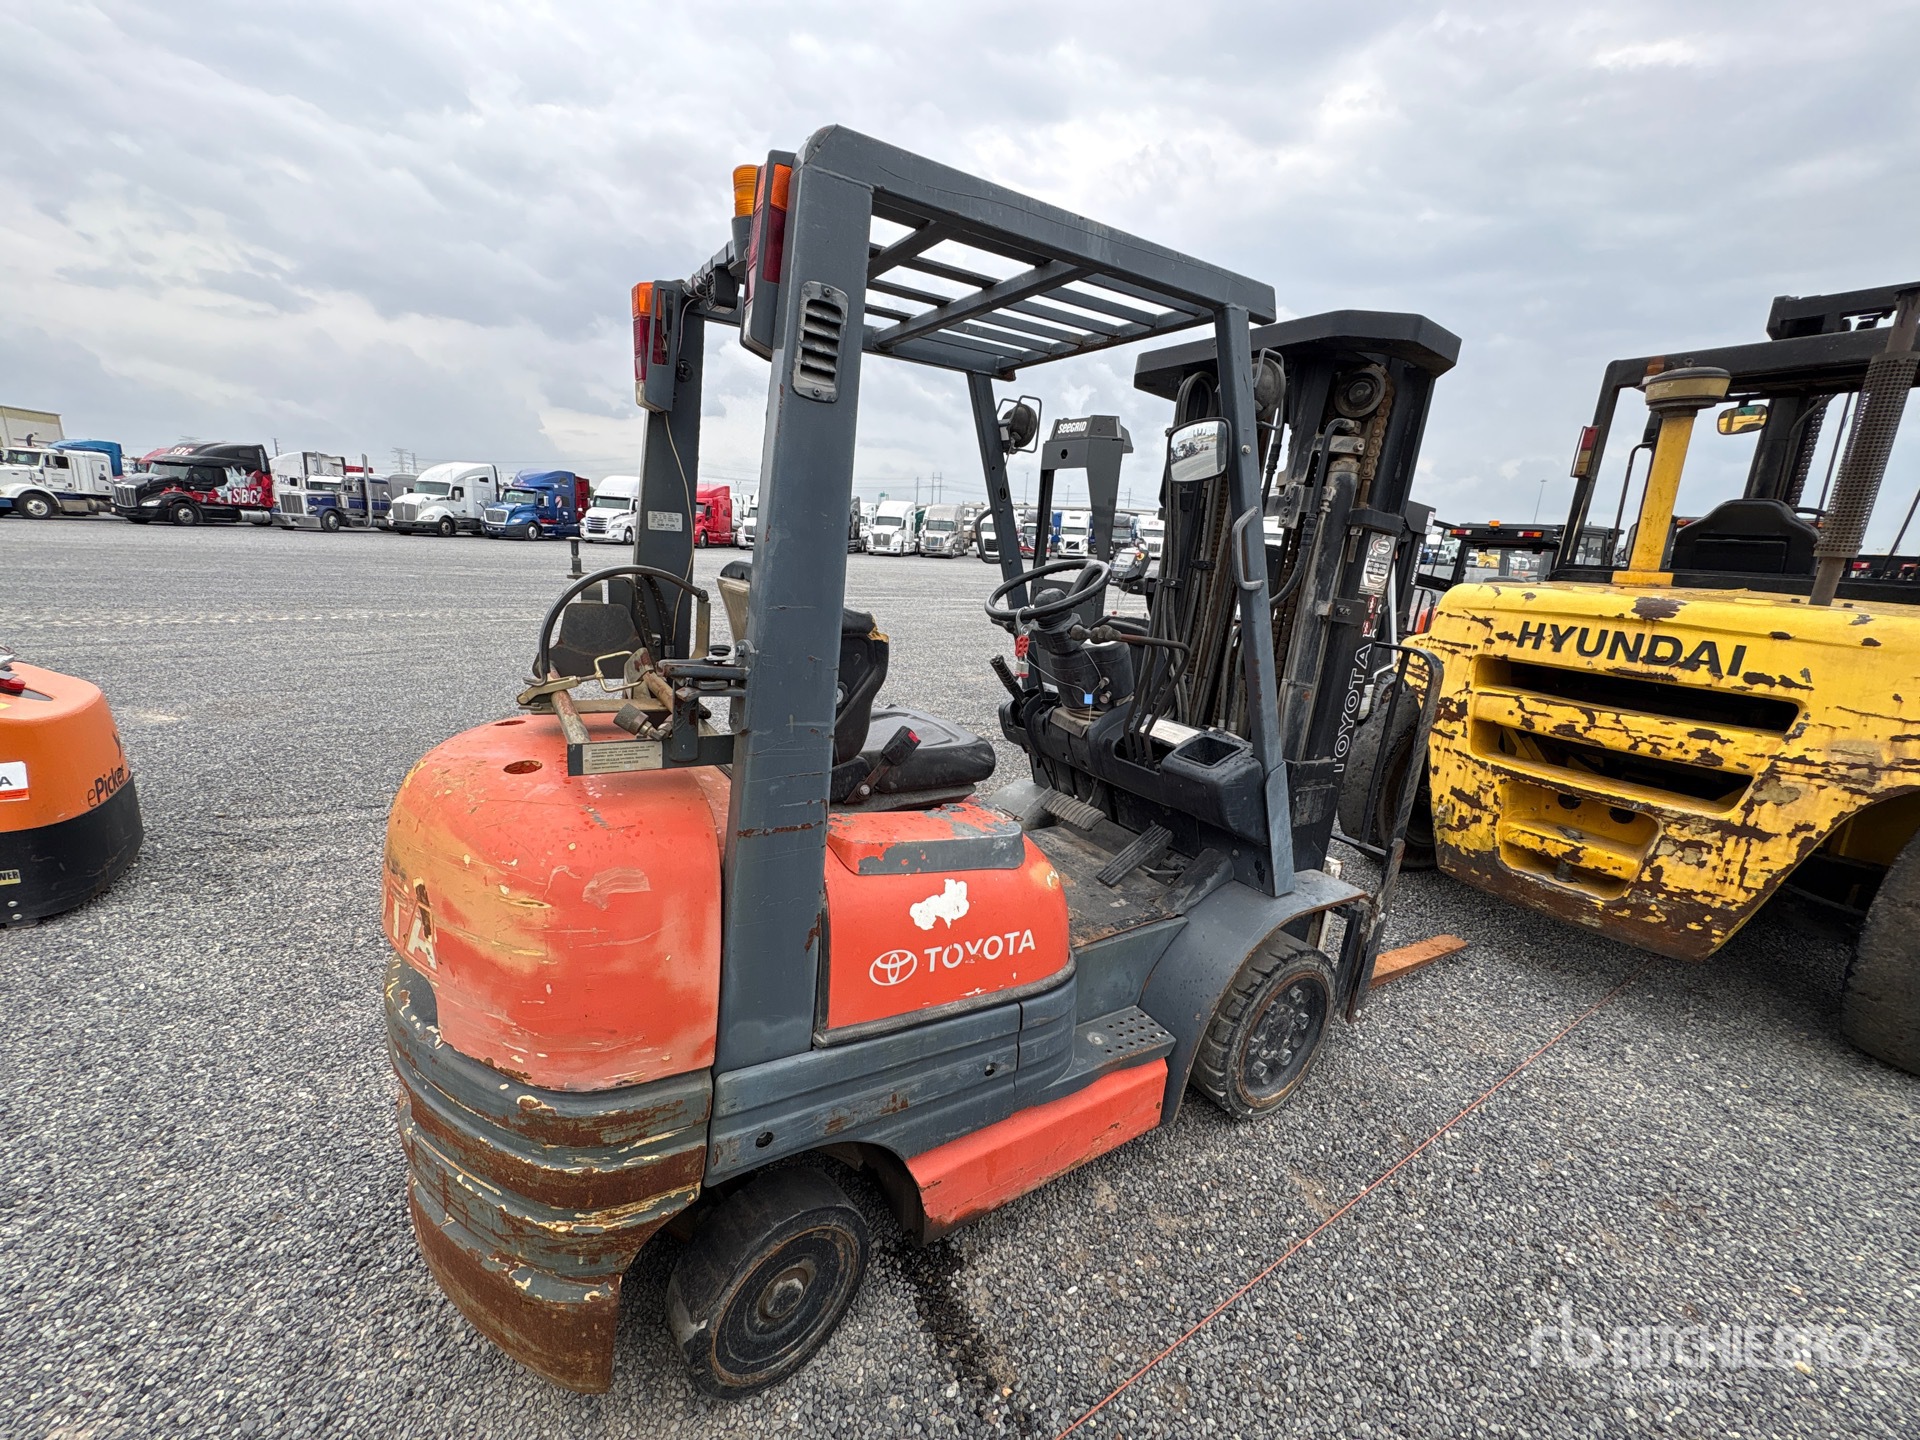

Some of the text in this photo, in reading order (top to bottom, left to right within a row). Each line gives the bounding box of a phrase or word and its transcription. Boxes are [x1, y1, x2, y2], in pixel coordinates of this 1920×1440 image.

[170, 446, 193, 456] SBC
[232, 488, 258, 504] SBC
[1516, 621, 1747, 677] HYUNDAI
[923, 928, 1036, 973] TOYOTA
